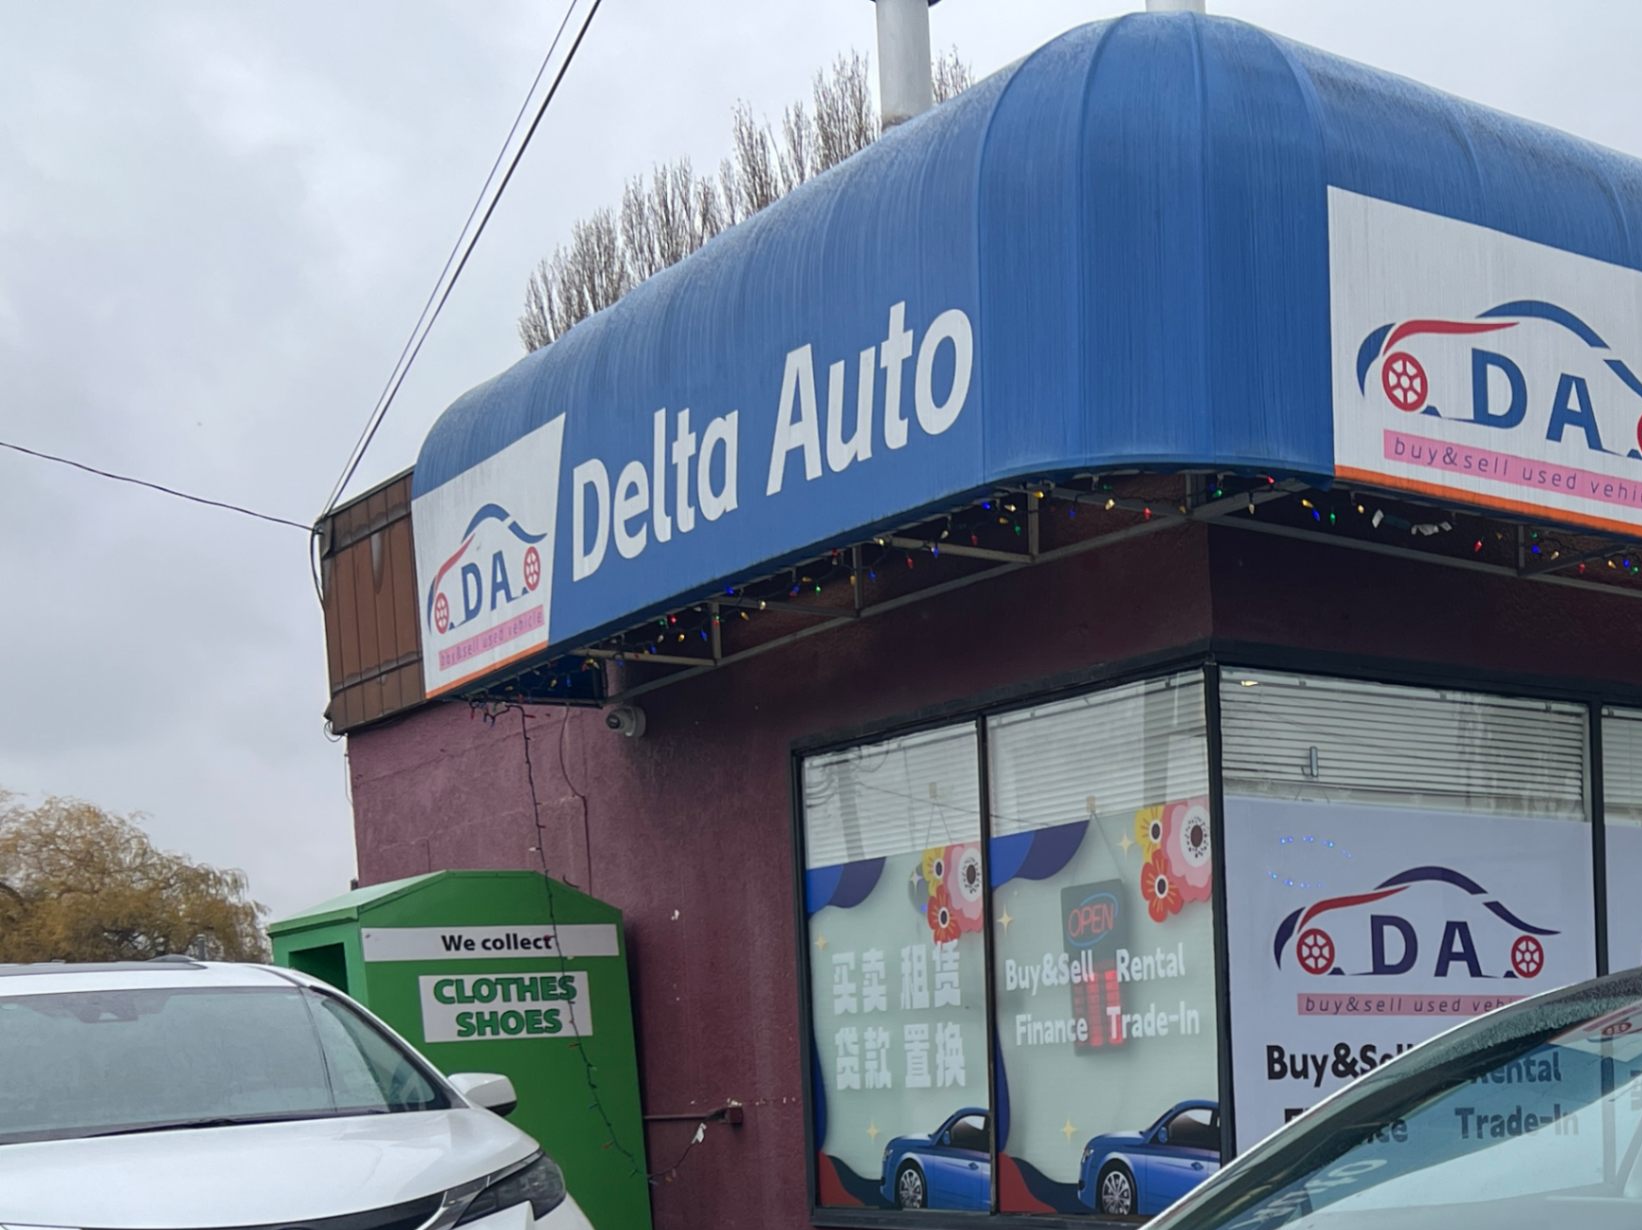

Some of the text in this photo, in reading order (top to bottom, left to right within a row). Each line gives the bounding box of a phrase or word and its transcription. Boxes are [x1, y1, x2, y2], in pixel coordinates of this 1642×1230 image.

[573, 301, 974, 582] Delta Auto
[1394, 437, 1508, 476] buy&sell
[1522, 465, 1577, 491] used
[1068, 903, 1114, 938] OPEN
[441, 932, 553, 951] We collect
[1005, 942, 1186, 996] Buy&Sell Rental
[433, 975, 577, 1005] CLOTHES
[1305, 996, 1402, 1015] buy&sell
[1413, 997, 1461, 1013] used
[456, 1008, 563, 1037] SHOES
[1016, 1001, 1200, 1046] Finance Trade-In
